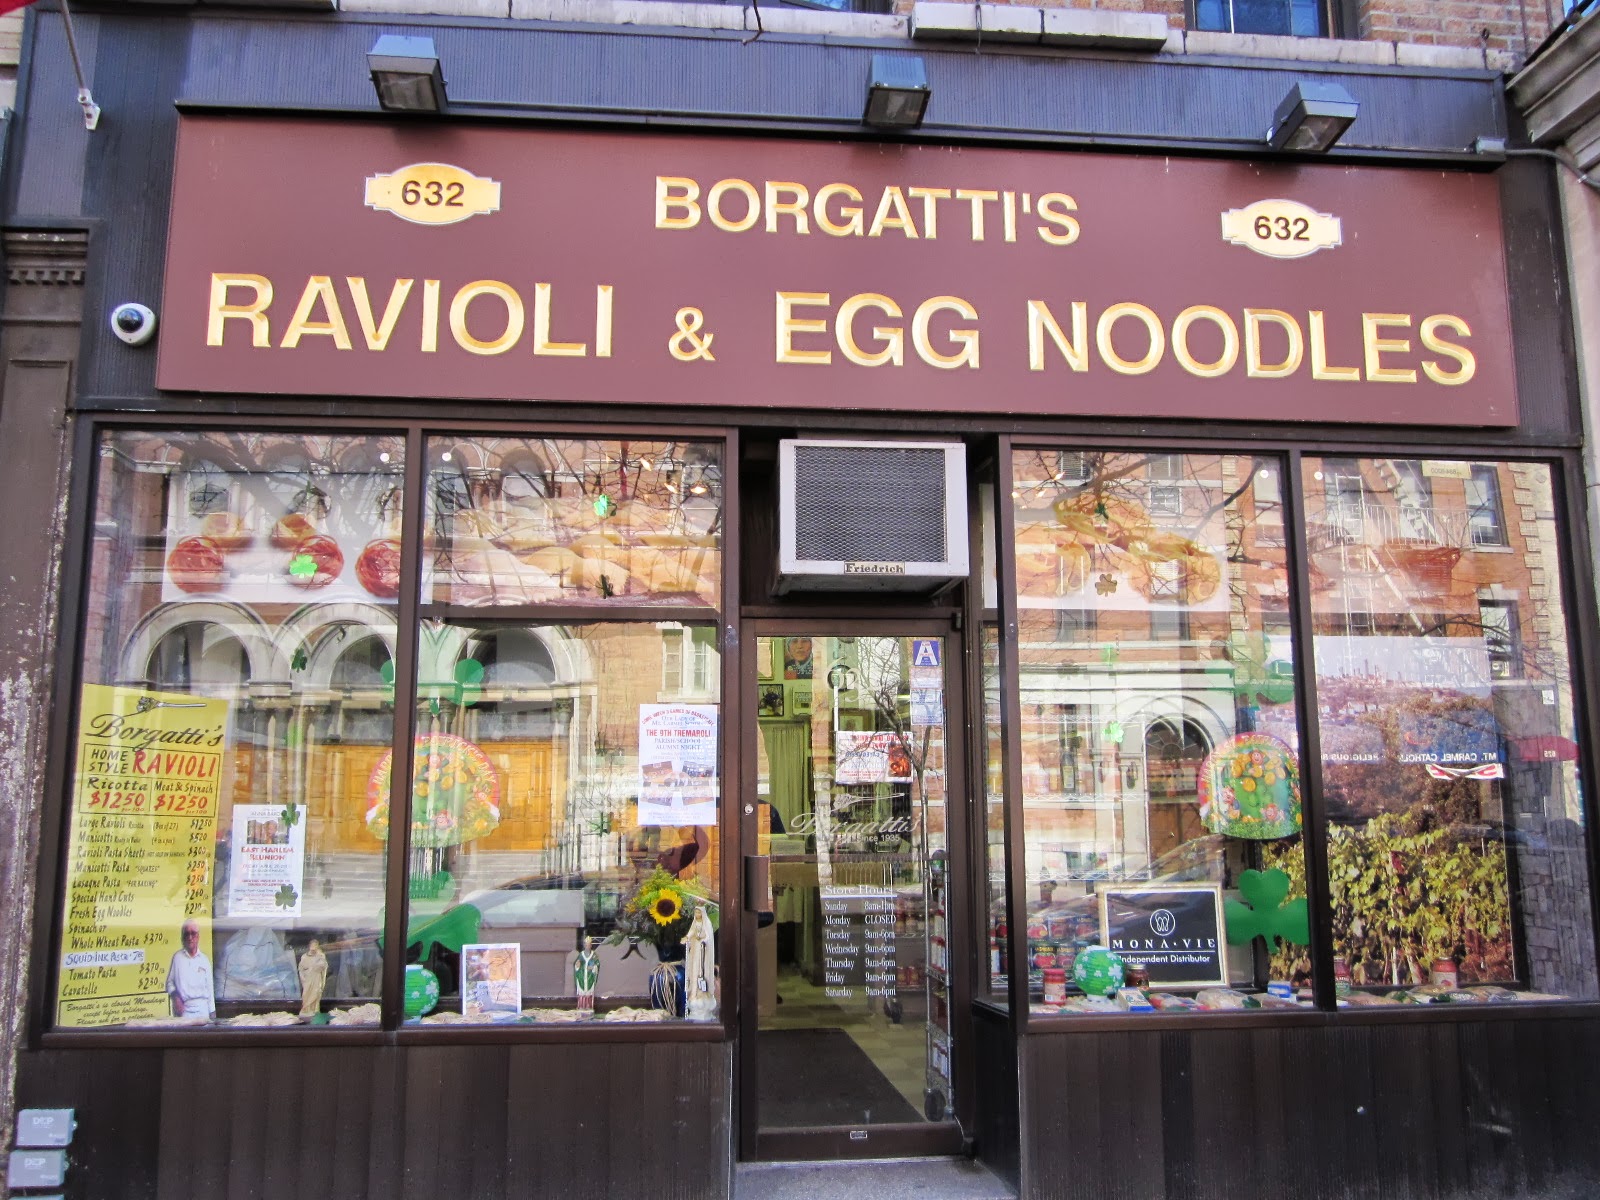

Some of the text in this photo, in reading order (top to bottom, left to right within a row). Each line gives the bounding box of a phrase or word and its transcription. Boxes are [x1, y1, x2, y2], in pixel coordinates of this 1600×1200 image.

[401, 180, 465, 208] 632
[654, 175, 1081, 246] BORGATTI'S
[1253, 215, 1311, 242] 632
[206, 272, 1477, 386] RAVIOLI & EGG NOODLES
[845, 562, 904, 573] Friedrich
[85, 714, 224, 752] Borgatti's
[646, 729, 658, 737] THE
[88, 761, 129, 774] STYLE
[91, 749, 217, 778] HOME RAVIOLI
[87, 776, 213, 796] Ricotta Meat & Spinach
[80, 816, 99, 831] Large
[100, 816, 125, 829] Ravioli
[79, 831, 113, 843] Manicotti
[880, 834, 900, 842] 1935
[77, 846, 103, 857] Ravioli
[105, 846, 122, 857] Pasta
[124, 846, 145, 857] Sheets
[261, 846, 294, 854] HARLEM
[249, 853, 286, 861] REUNION
[74, 861, 110, 873] Manicotti
[111, 861, 130, 872] Pasta
[73, 876, 100, 892] Lasagne
[102, 876, 121, 889] Pasta
[825, 884, 893, 895] Store Hours
[72, 892, 98, 904] Special
[99, 891, 117, 903] Hand
[118, 892, 135, 902] Cuts
[825, 901, 848, 911] Sunday
[69, 906, 90, 920] Fresh
[92, 906, 105, 921] Egg
[107, 905, 133, 917] Noodles
[825, 915, 896, 927] Monday CLOSED
[68, 923, 107, 935] Spinach or
[825, 929, 851, 941] Tuesday
[71, 936, 94, 949] Whole
[95, 936, 119, 949] Wheat
[121, 935, 140, 947] Pasta
[825, 943, 896, 955] Wednesday 9am-6pm
[825, 957, 896, 970] Thursday 9am-6pm
[1170, 954, 1210, 963] Distributor
[69, 968, 96, 981] Tomato
[97, 966, 117, 979] Pasta
[825, 972, 896, 984] Friday 9am-6pm
[825, 986, 896, 998] Saturday 9am-6pm
